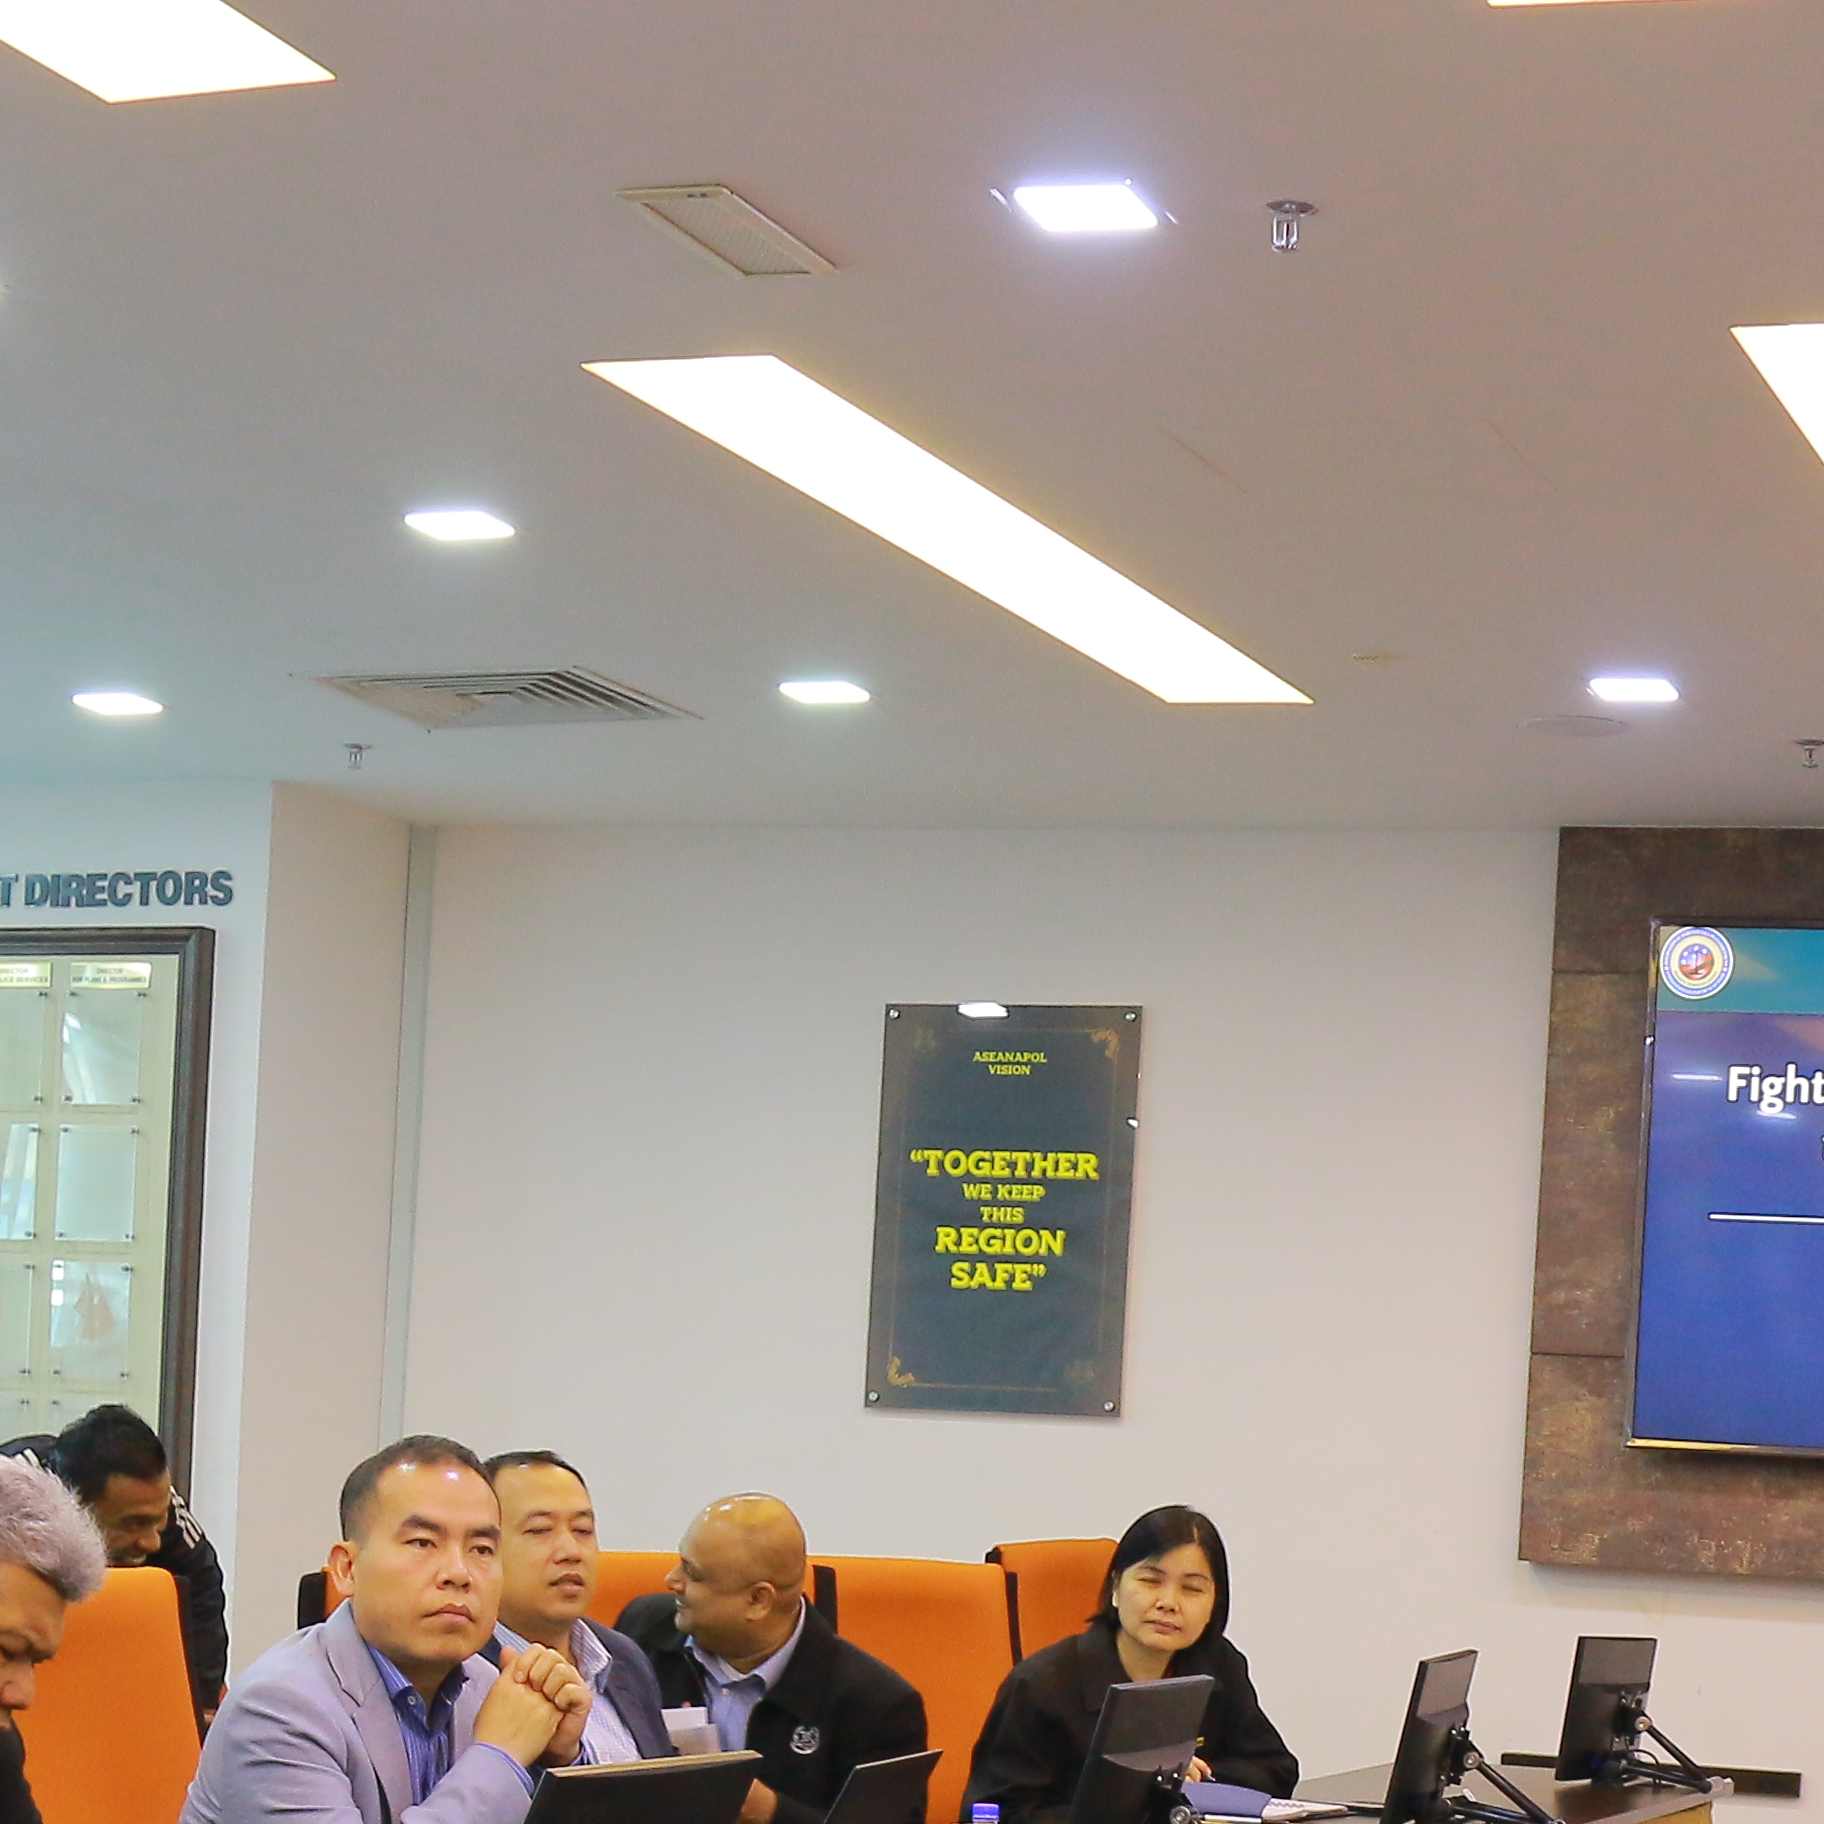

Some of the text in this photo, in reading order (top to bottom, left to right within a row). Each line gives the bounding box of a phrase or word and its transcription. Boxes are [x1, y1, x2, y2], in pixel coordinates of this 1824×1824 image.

[24, 869, 234, 908] DIRECTORS
[972, 1051, 1047, 1064] ASEANAPOL
[988, 1064, 1031, 1076] VISION
[962, 1183, 1047, 1201] WE KEEP
[980, 1206, 1025, 1223] THIS
[934, 1226, 1066, 1257] REGION
